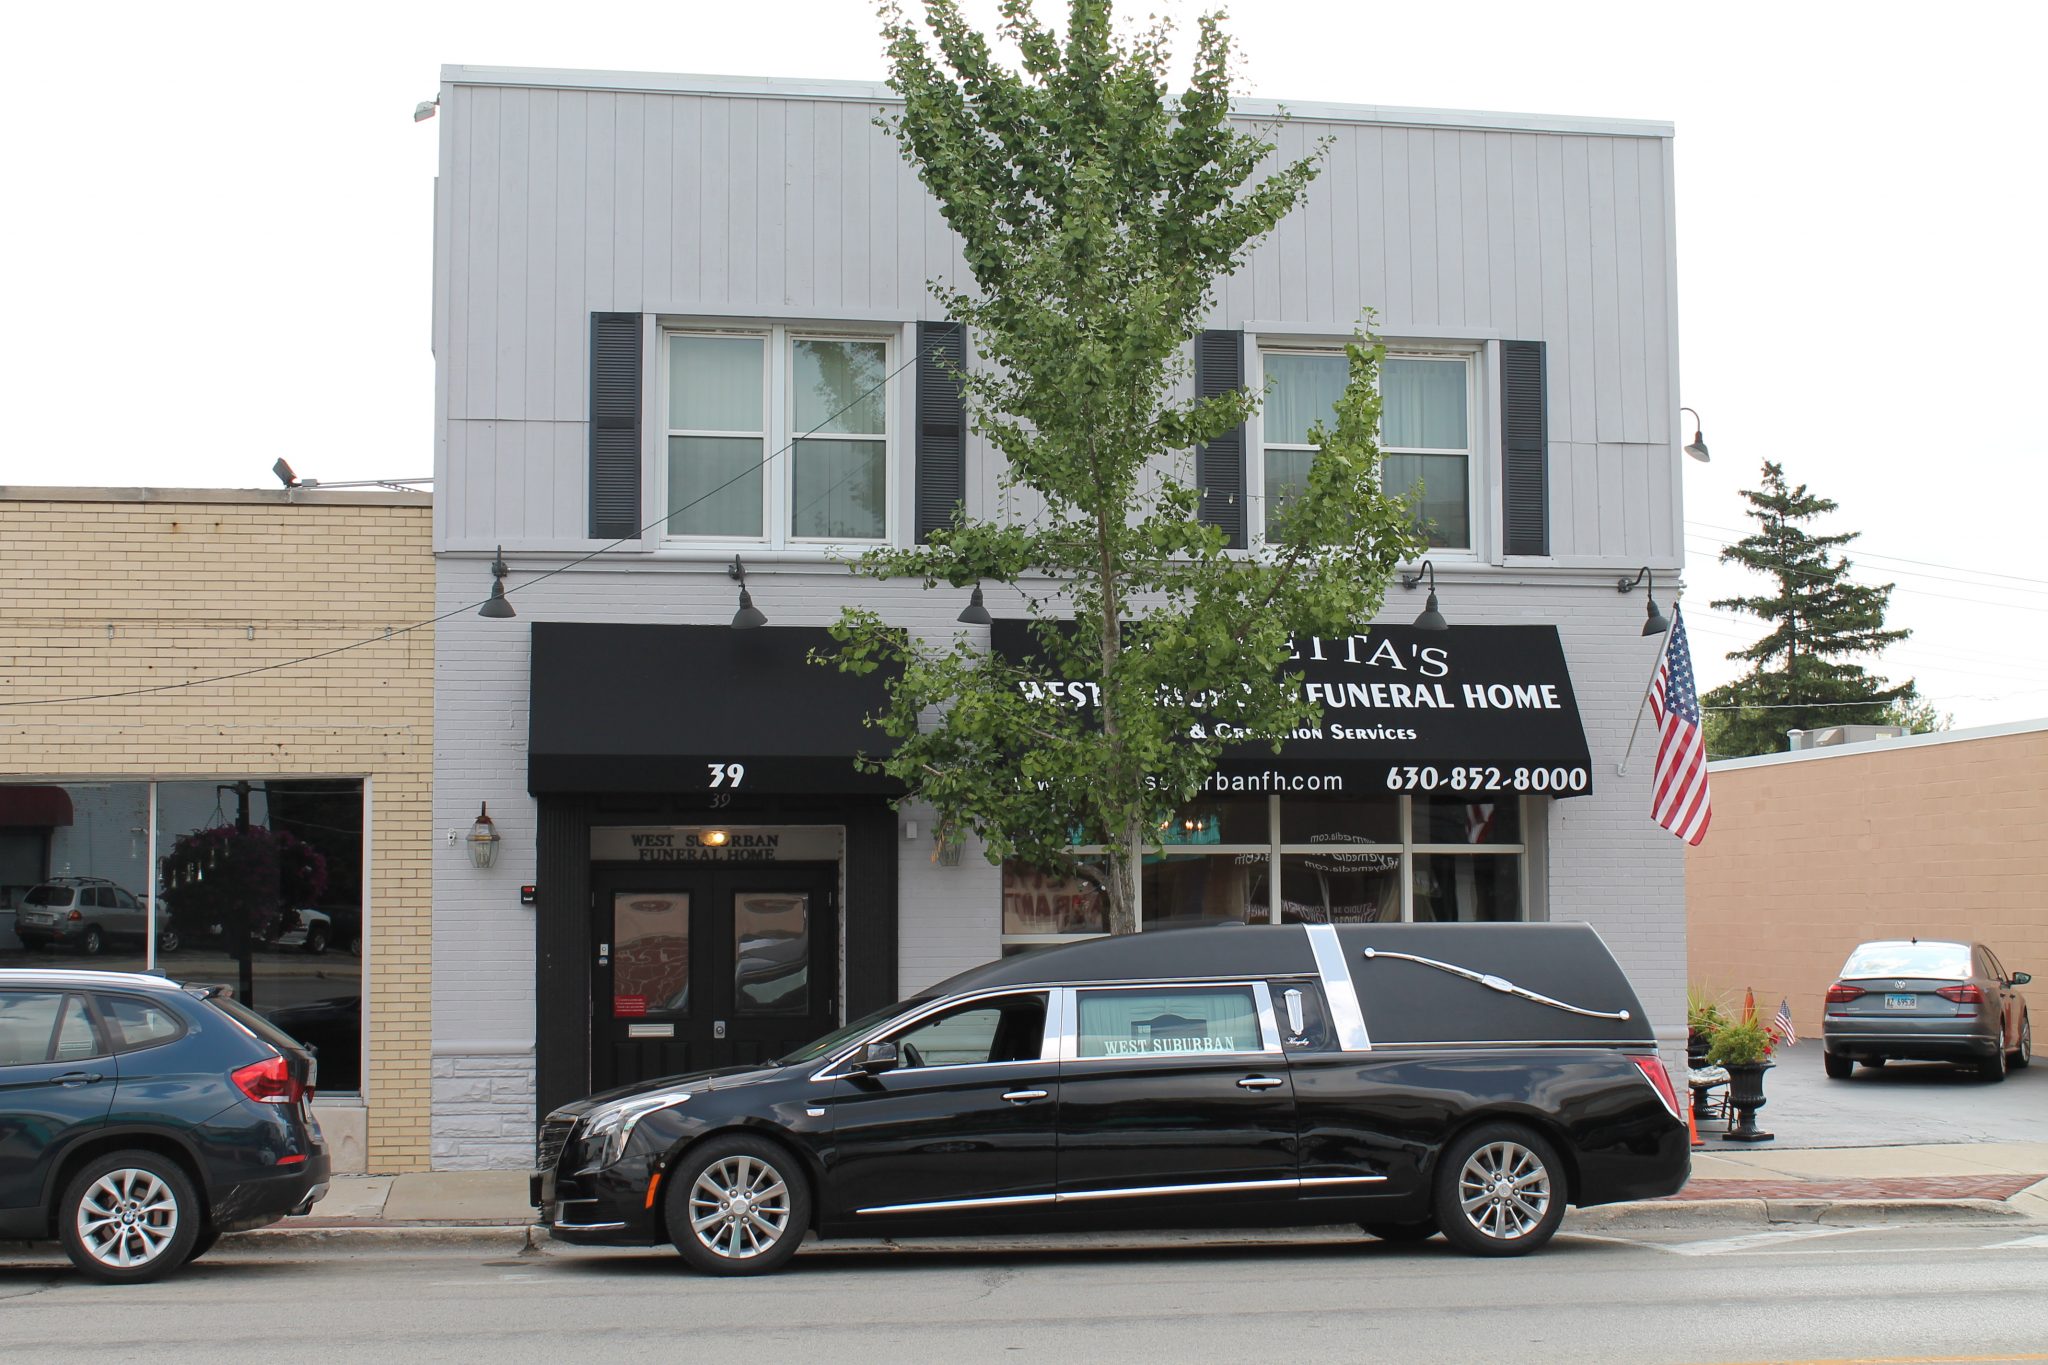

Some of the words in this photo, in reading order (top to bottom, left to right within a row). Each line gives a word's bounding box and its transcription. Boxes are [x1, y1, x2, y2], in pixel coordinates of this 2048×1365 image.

[1306, 683, 1454, 708] FUNERAL
[1462, 684, 1561, 709] HOME
[1190, 723, 1207, 738] &
[708, 763, 744, 788] 39
[1387, 767, 1587, 791] 630-852-8000
[709, 793, 731, 809] 39
[631, 835, 674, 847] WEST
[638, 848, 722, 861] FUNERAL
[728, 849, 775, 861] HOME
[1105, 1039, 1147, 1055] WEST
[1153, 1036, 1234, 1053] SUBURBAN
